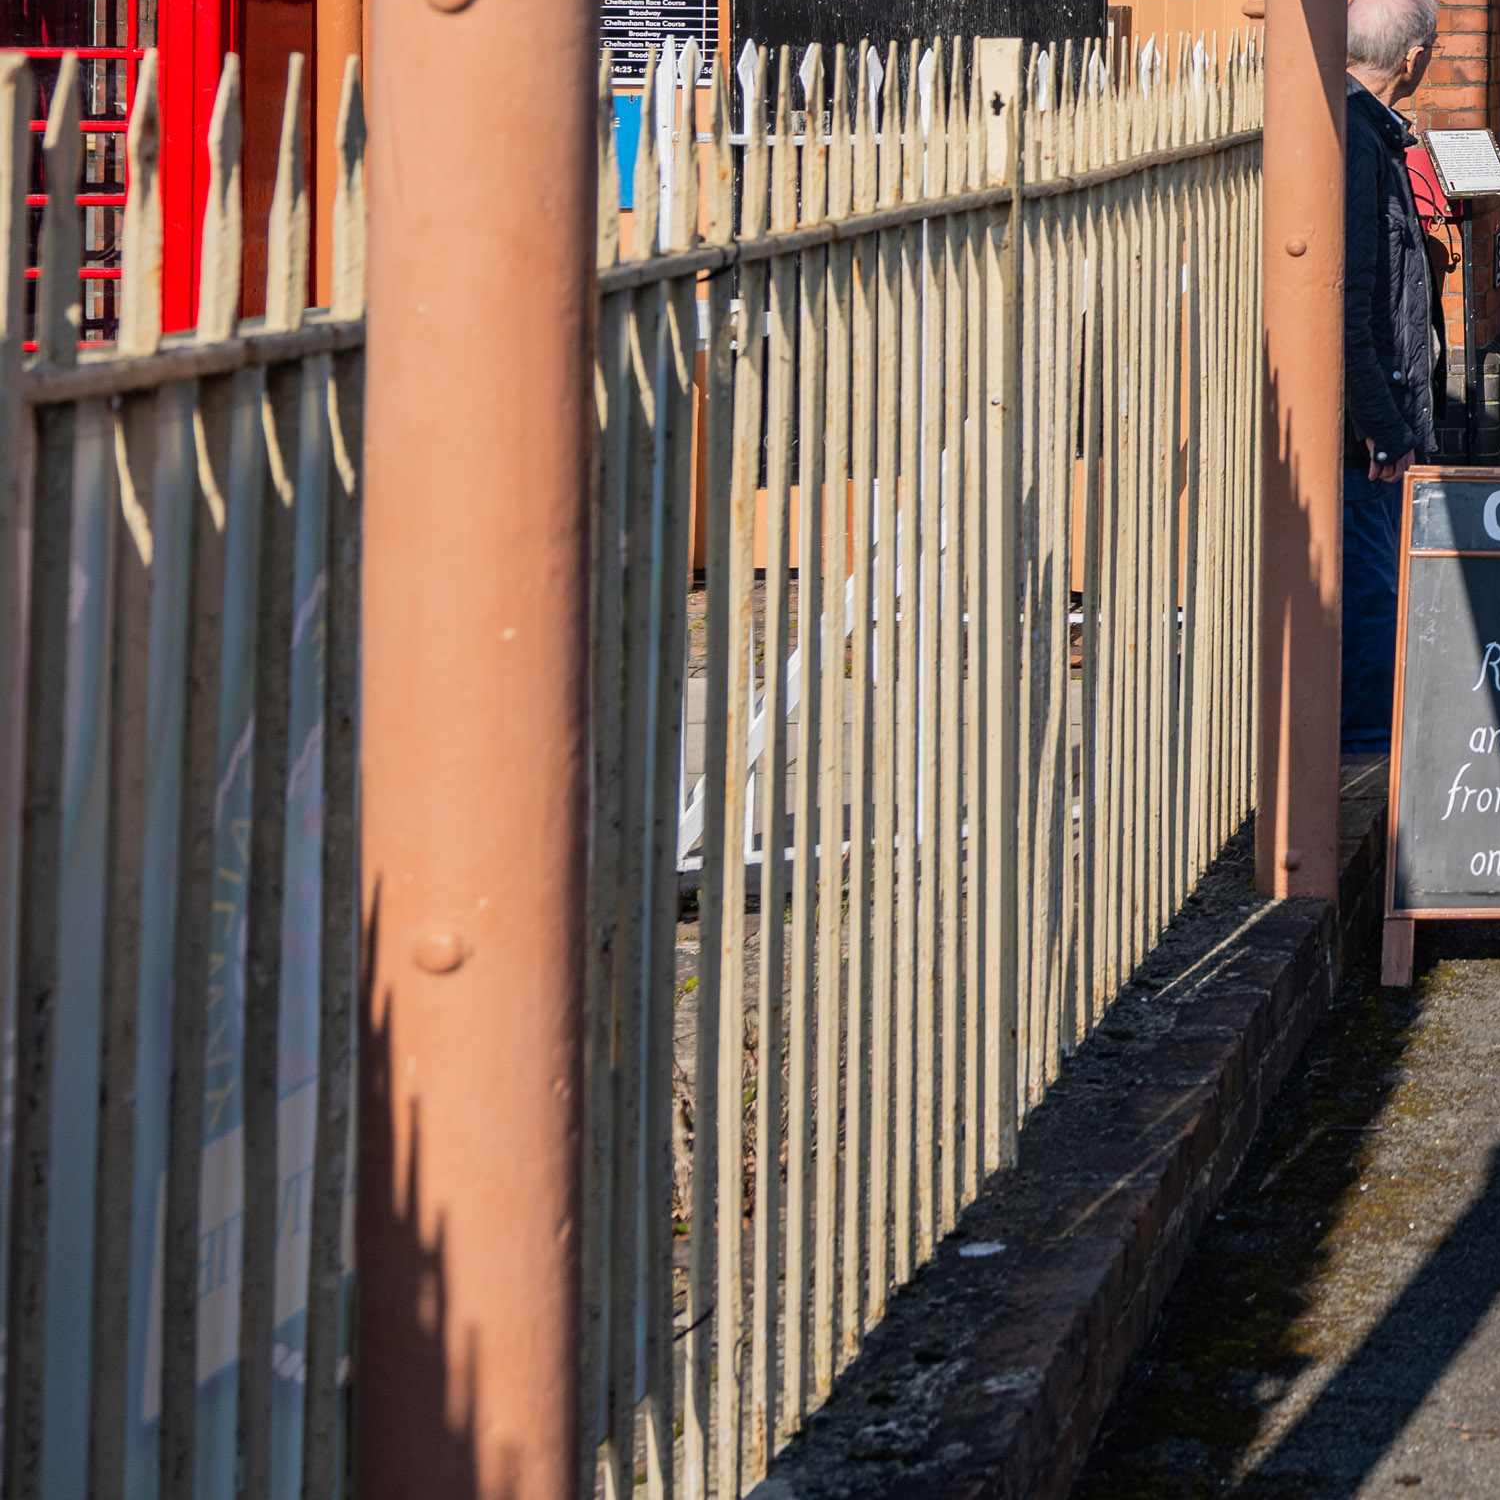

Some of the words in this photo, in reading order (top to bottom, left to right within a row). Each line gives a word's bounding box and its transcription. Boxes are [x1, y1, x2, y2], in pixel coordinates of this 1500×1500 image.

[628, 9, 662, 17] Broadway
[628, 30, 661, 38] Broadway
[628, 51, 660, 59] Broady
